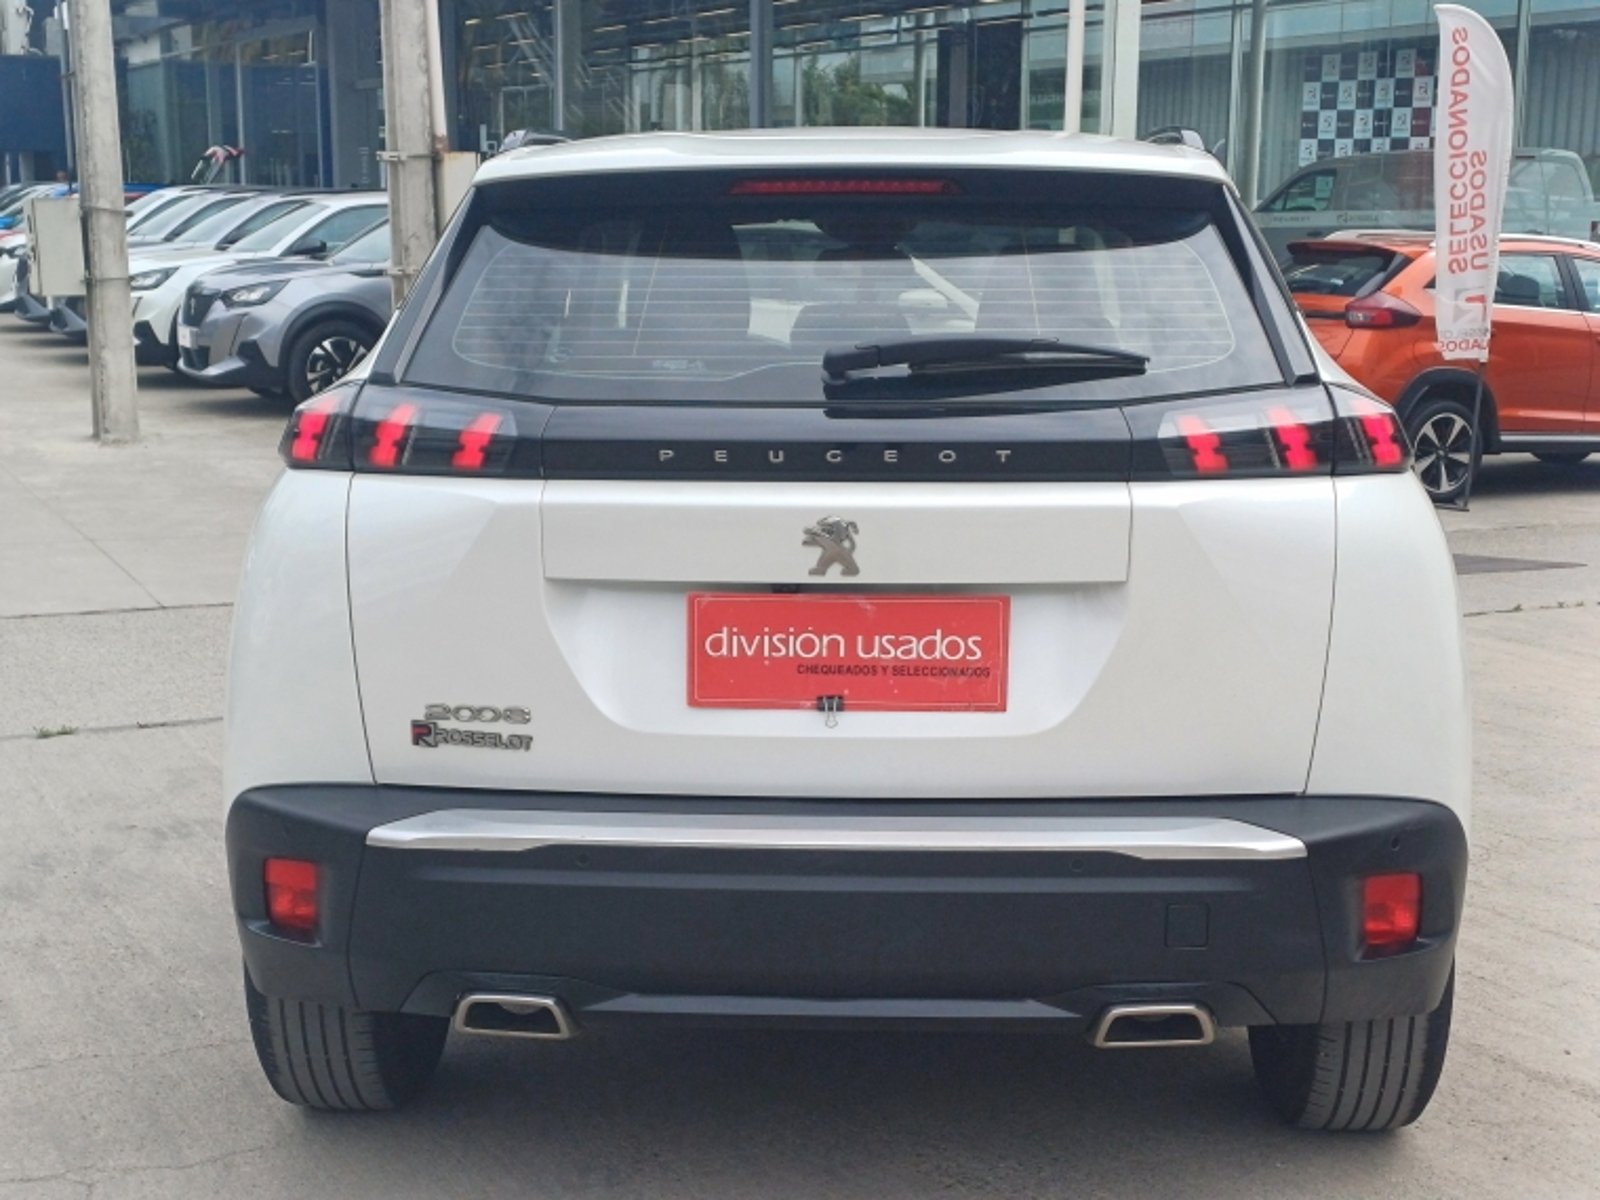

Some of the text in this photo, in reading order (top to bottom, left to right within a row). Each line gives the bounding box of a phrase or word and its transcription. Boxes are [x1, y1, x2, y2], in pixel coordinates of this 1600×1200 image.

[658, 449, 1012, 463] PEUGEOT
[704, 626, 982, 660] división usados
[796, 664, 991, 679] CHEQUEADOS Y SELECCIONADOS
